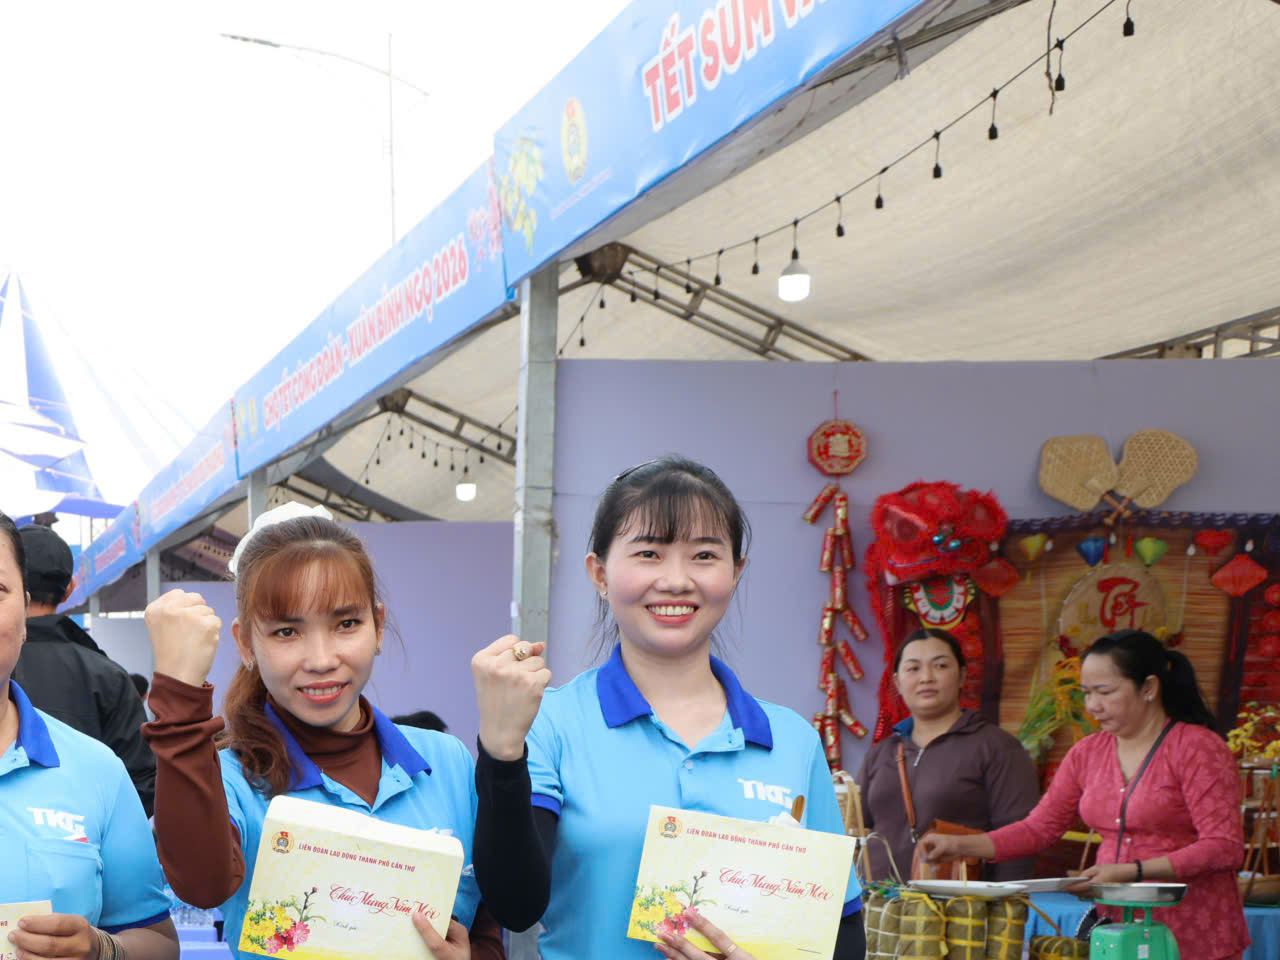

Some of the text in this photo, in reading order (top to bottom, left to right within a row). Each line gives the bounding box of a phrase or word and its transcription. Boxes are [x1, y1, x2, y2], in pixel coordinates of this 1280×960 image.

[643, 0, 773, 130] TẾT SUM
[347, 305, 377, 367] XUÂN
[376, 282, 405, 343] BÍNH
[405, 263, 433, 322] NGỌ
[433, 234, 468, 303] 2026
[718, 833, 729, 841] LAO
[329, 849, 340, 857] LAO
[719, 867, 749, 888] Chúc
[751, 873, 784, 897] Mừng
[329, 884, 358, 904] Chúc
[359, 890, 392, 914] Mừng
